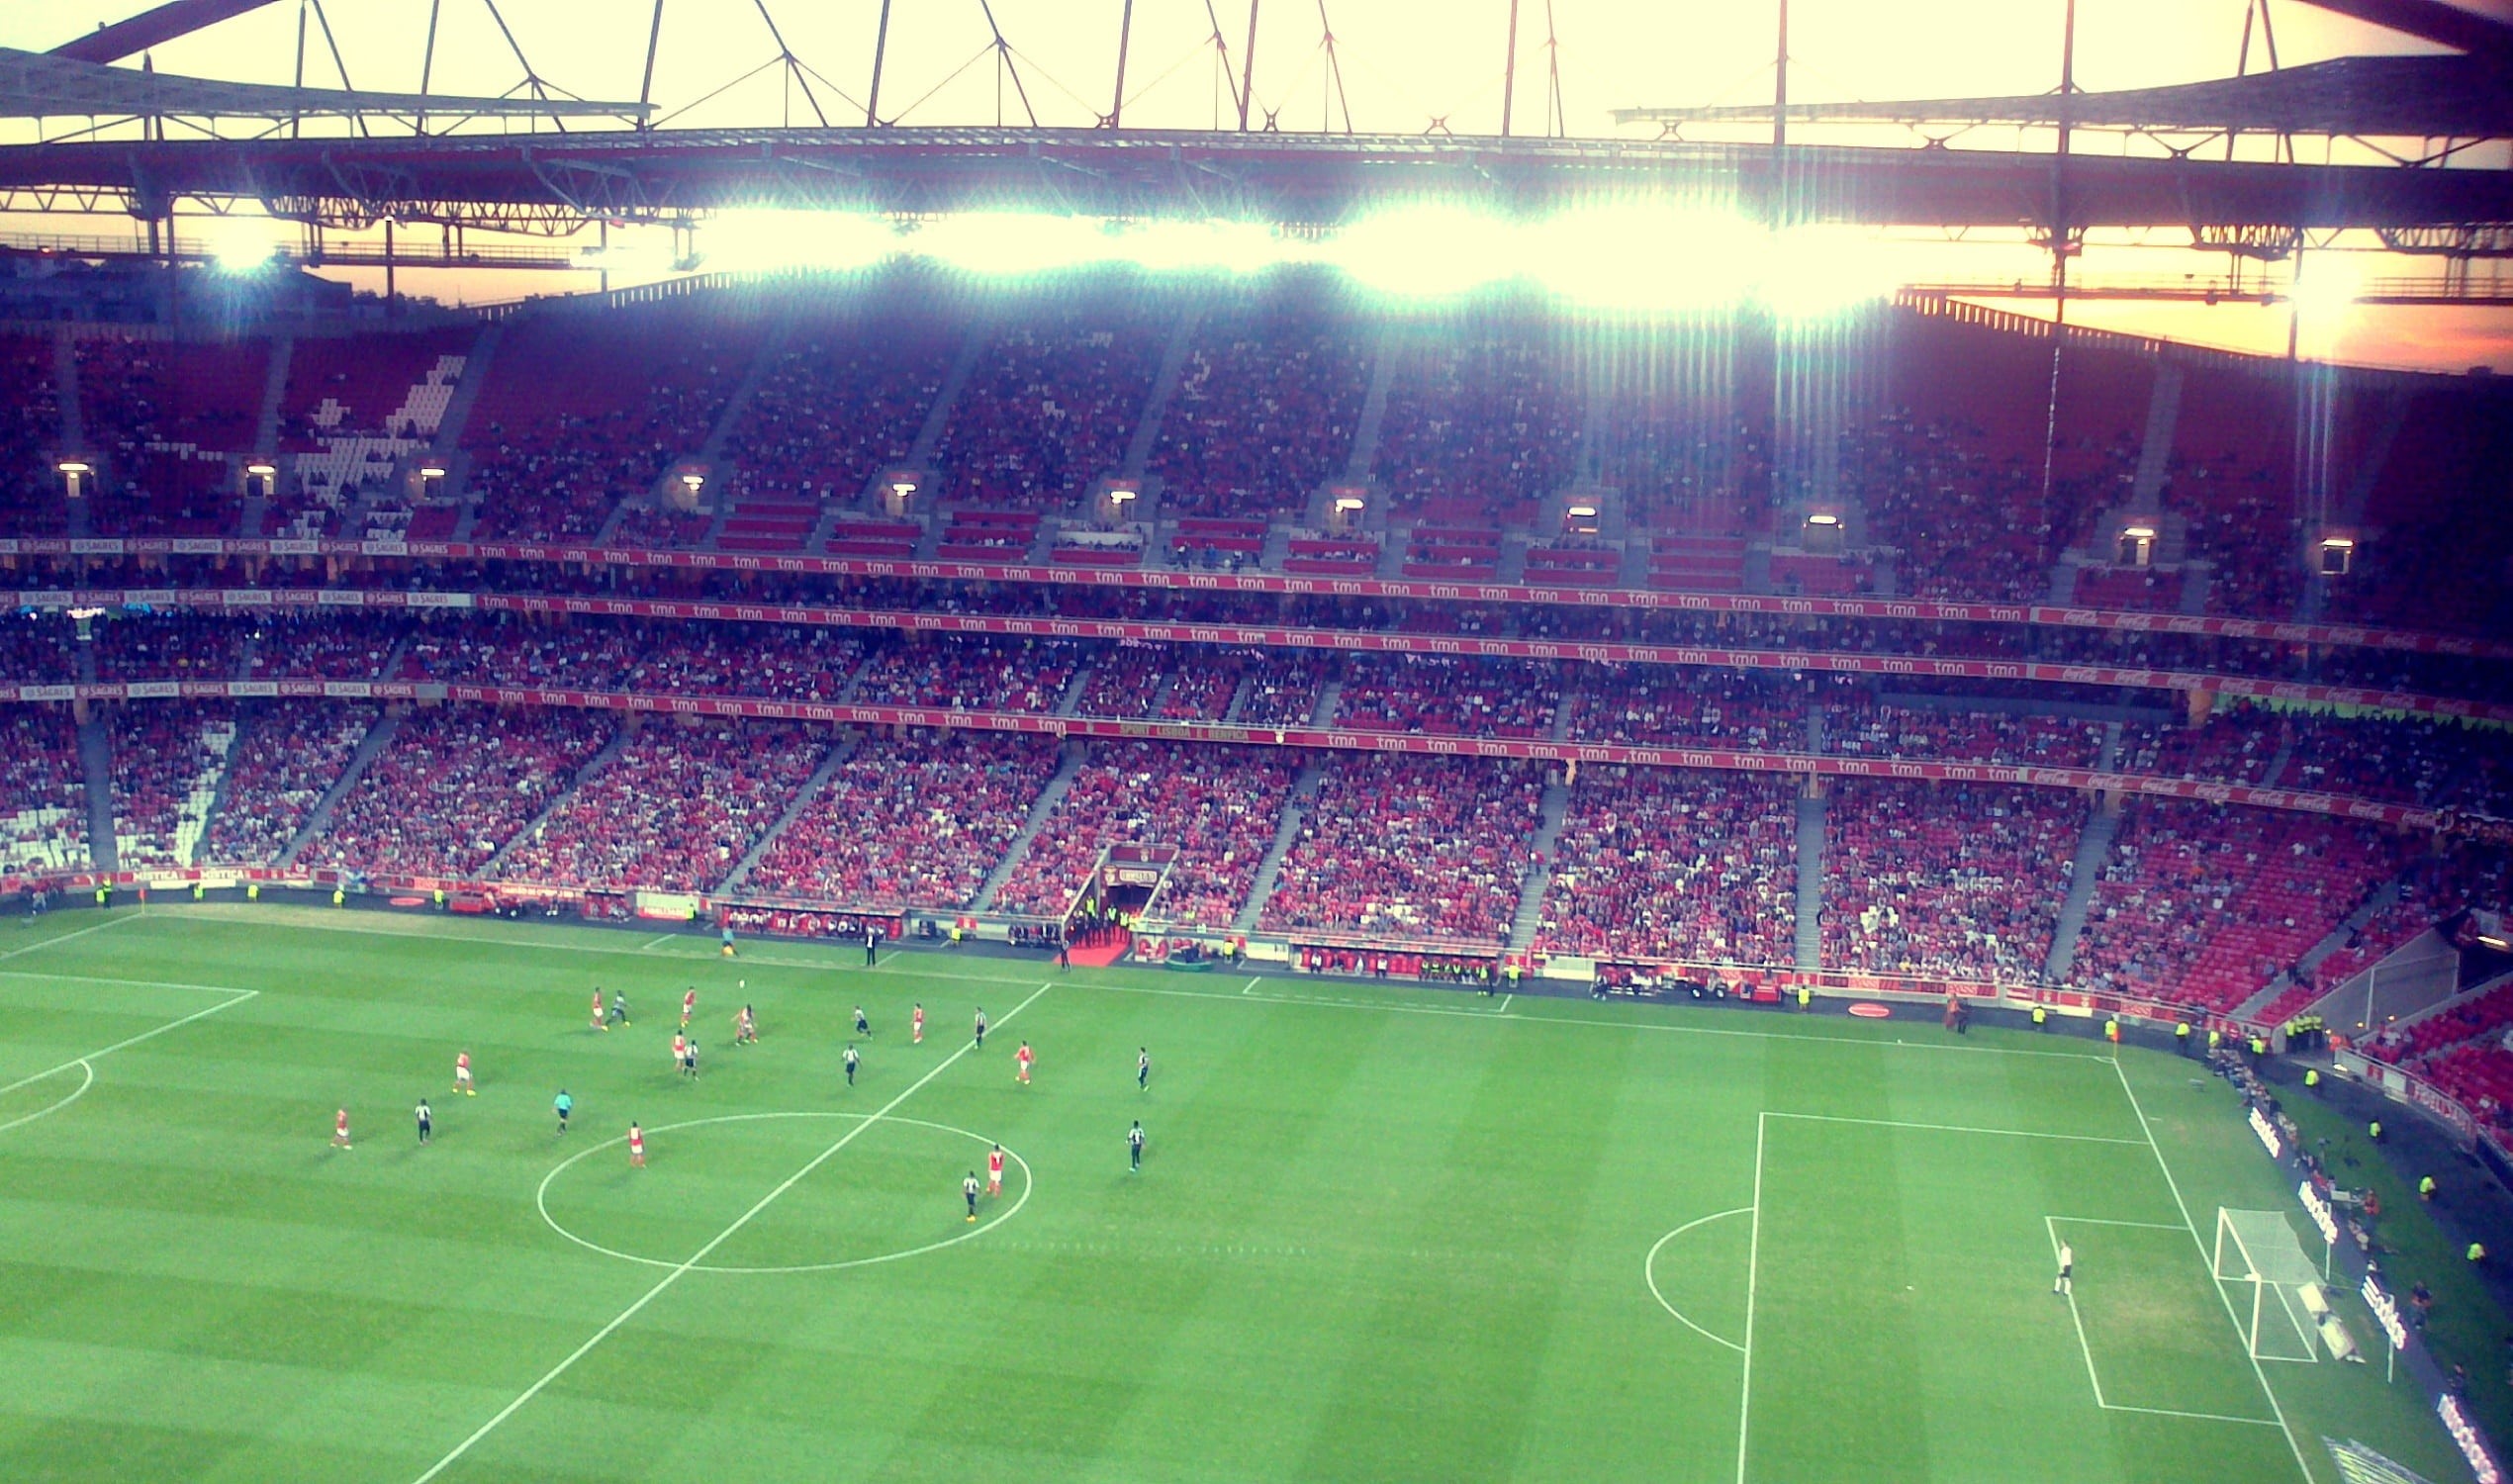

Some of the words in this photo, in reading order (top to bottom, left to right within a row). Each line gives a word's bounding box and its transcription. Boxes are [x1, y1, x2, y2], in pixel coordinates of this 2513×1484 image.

[481, 546, 506, 558] tmn
[520, 547, 544, 559] tmn
[604, 549, 629, 562] tmn
[647, 550, 673, 564] tmn
[690, 552, 715, 566] tmn
[733, 554, 760, 568] tmn
[778, 558, 803, 570] tmn
[821, 560, 849, 572] tmn
[867, 562, 892, 574] tmn
[911, 563, 938, 576] tmn
[958, 565, 984, 578] tmn
[1002, 567, 1030, 580] tmn
[1048, 569, 1076, 582] tmn
[1095, 572, 1122, 584] tmn
[1142, 573, 1169, 586] tmn
[1188, 574, 1217, 588] tmn
[1236, 576, 1264, 590] tmn
[1284, 578, 1312, 592] tmn
[1332, 580, 1360, 593] tmn
[1381, 583, 1409, 596] tmn
[1429, 585, 1458, 598] tmn
[1478, 586, 1508, 600] tmn
[1529, 588, 1557, 602] tmn
[1579, 591, 1608, 603] tmn
[1629, 592, 1658, 605] tmn
[1679, 595, 1710, 607] tmn
[1730, 596, 1760, 609] tmn
[1781, 598, 1812, 611] tmn
[1832, 600, 1863, 614] tmn
[1884, 603, 1915, 616] tmn
[1937, 603, 1968, 618] tmn
[1989, 607, 2020, 620] tmn
[484, 597, 509, 607] tmn
[523, 598, 548, 609] tmn
[565, 600, 591, 611] tmn
[607, 602, 632, 613] tmn
[650, 603, 675, 615] tmn
[694, 604, 719, 617] tmn
[736, 606, 763, 619] tmn
[781, 609, 807, 621] tmn
[824, 611, 851, 623] tmn
[869, 613, 895, 626] tmn
[913, 614, 941, 627] tmn
[959, 617, 985, 630] tmn
[1004, 619, 1032, 633] tmn
[1050, 621, 1078, 634] tmn
[1096, 624, 1124, 636] tmn
[1144, 625, 1171, 639] tmn
[1189, 628, 1218, 641] tmn
[1285, 632, 1314, 645] tmn
[1333, 633, 1361, 647] tmn
[1381, 636, 1410, 650] tmn
[1430, 639, 1458, 651] tmn
[1478, 640, 1508, 654] tmn
[1528, 643, 1557, 656] tmn
[1577, 645, 1607, 659] tmn
[1628, 647, 1657, 661] tmn
[1678, 651, 1708, 663] tmn
[1727, 653, 1758, 665] tmn
[1779, 654, 1810, 668] tmn
[1830, 656, 1860, 670] tmn
[1882, 659, 1912, 673] tmn
[1933, 661, 1965, 674] tmn
[1986, 664, 2016, 677] tmn
[457, 688, 482, 698] tmn
[499, 691, 524, 702] tmn
[540, 693, 566, 704] tmn
[584, 695, 609, 706] tmn
[627, 696, 653, 709] tmn
[671, 698, 698, 711] tmn
[715, 700, 742, 714] tmn
[756, 702, 784, 715] tmn
[805, 705, 833, 718] tmn
[851, 708, 879, 720] tmn
[897, 710, 925, 724] tmn
[943, 712, 972, 726] tmn
[990, 715, 1019, 728] tmn
[1037, 718, 1067, 732] tmn
[1327, 735, 1356, 747] tmn
[1376, 737, 1406, 750] tmn
[1427, 739, 1456, 752] tmn
[1476, 742, 1507, 754] tmn
[1528, 744, 1557, 758] tmn
[1578, 746, 1609, 760] tmn
[1629, 750, 1660, 763] tmn
[1682, 752, 1713, 766] tmn
[1733, 754, 1764, 768] tmn
[1785, 757, 1815, 771] tmn
[1837, 760, 1869, 773] tmn
[1890, 762, 1921, 776] tmn
[1943, 764, 1976, 778] tmn
[1987, 768, 2018, 780] tmn
